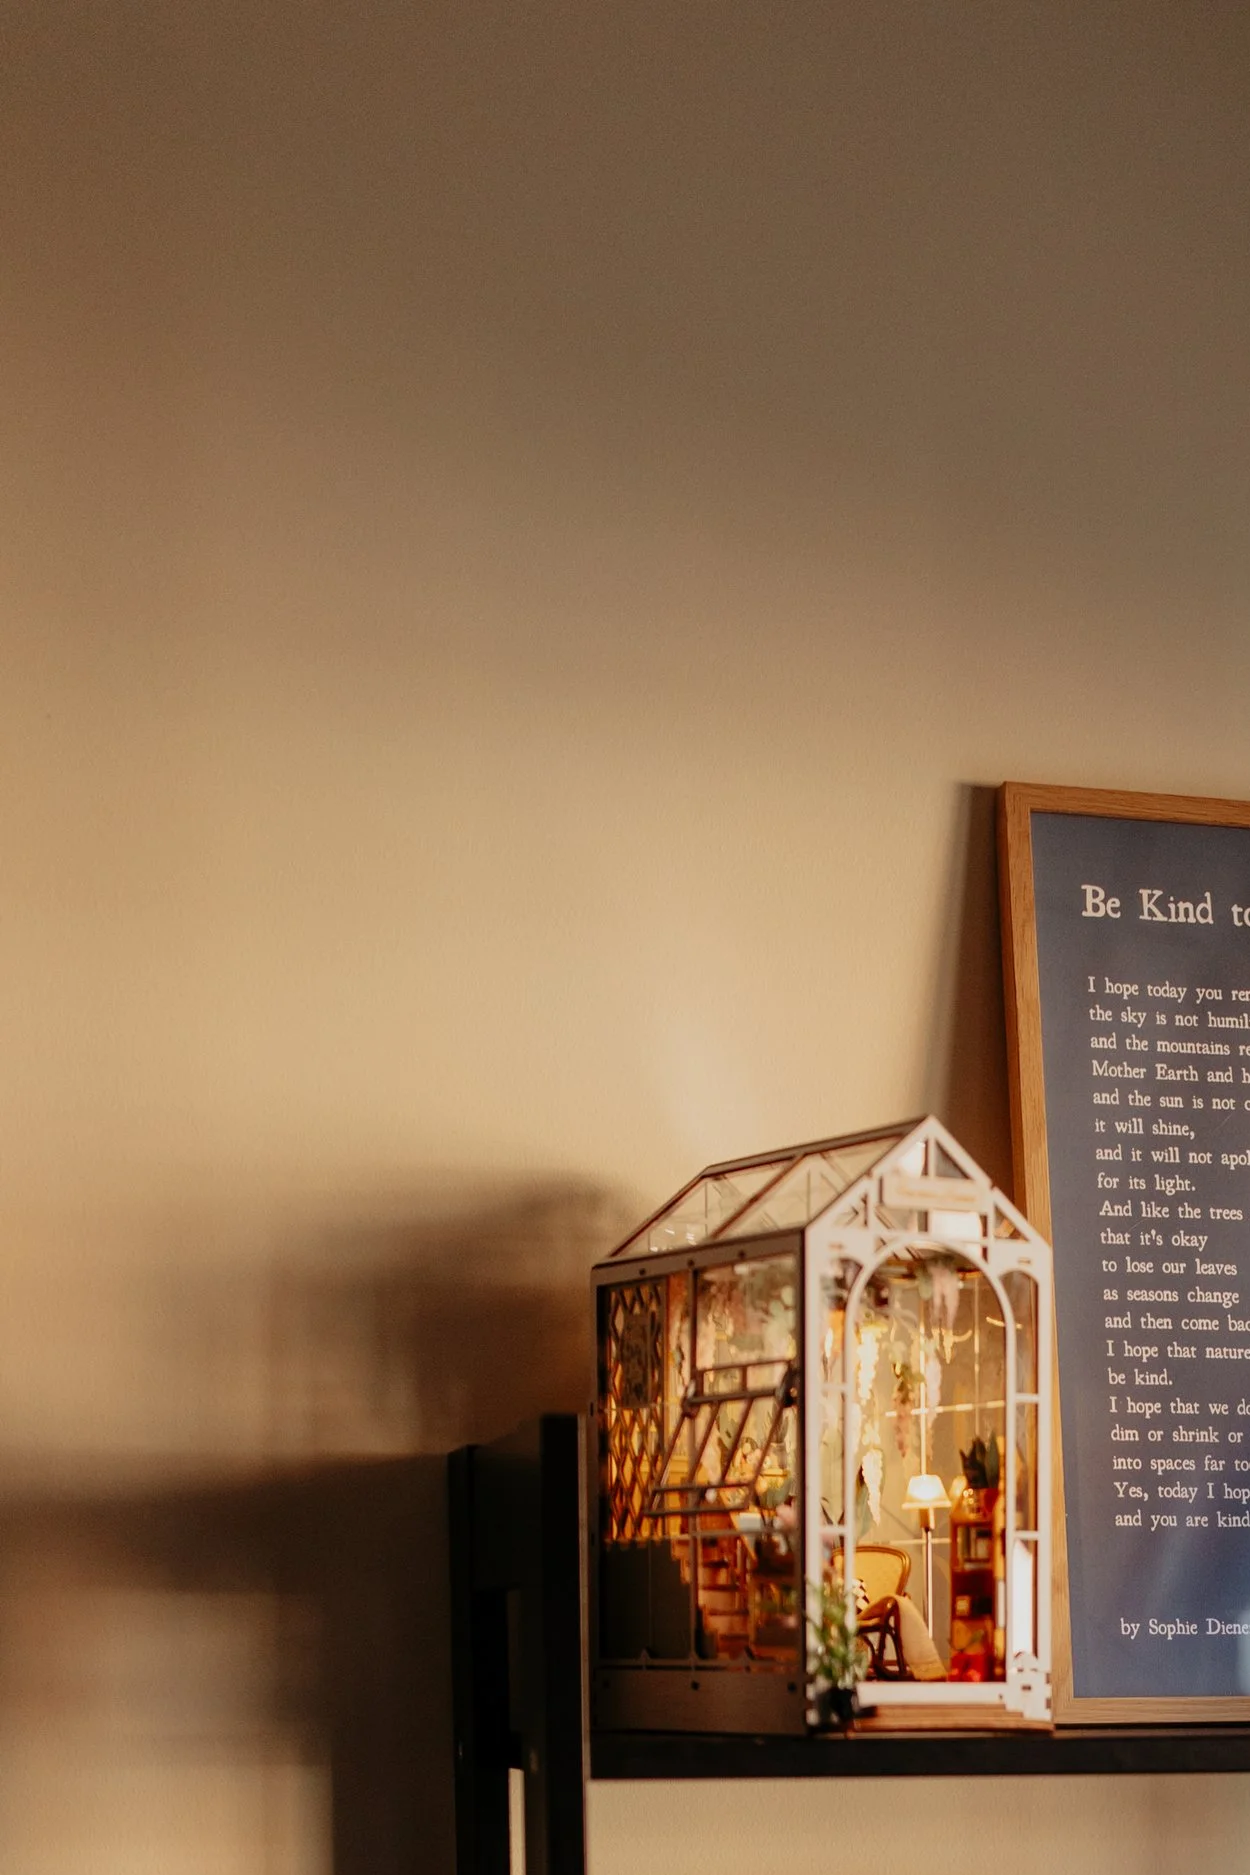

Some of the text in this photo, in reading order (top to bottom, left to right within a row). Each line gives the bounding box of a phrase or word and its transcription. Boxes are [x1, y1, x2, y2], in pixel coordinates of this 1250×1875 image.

[1081, 884, 1121, 918] Be
[1139, 889, 1214, 924] Kind
[1088, 976, 1096, 992] I
[1104, 977, 1139, 1000] hope
[1147, 981, 1187, 1003] today
[1196, 988, 1223, 1004] you
[1090, 1032, 1117, 1049] and
[1125, 1034, 1148, 1051] the
[1157, 1041, 1230, 1055] mountains
[1092, 1060, 1147, 1079] Mother
[1155, 1063, 1199, 1081] Earth
[1207, 1066, 1233, 1083] and
[1103, 1286, 1239, 1309] as seasons change
[1108, 1367, 1173, 1385] be kind.
[1120, 1617, 1140, 1640] by
[1149, 1618, 1198, 1640] Sophie
